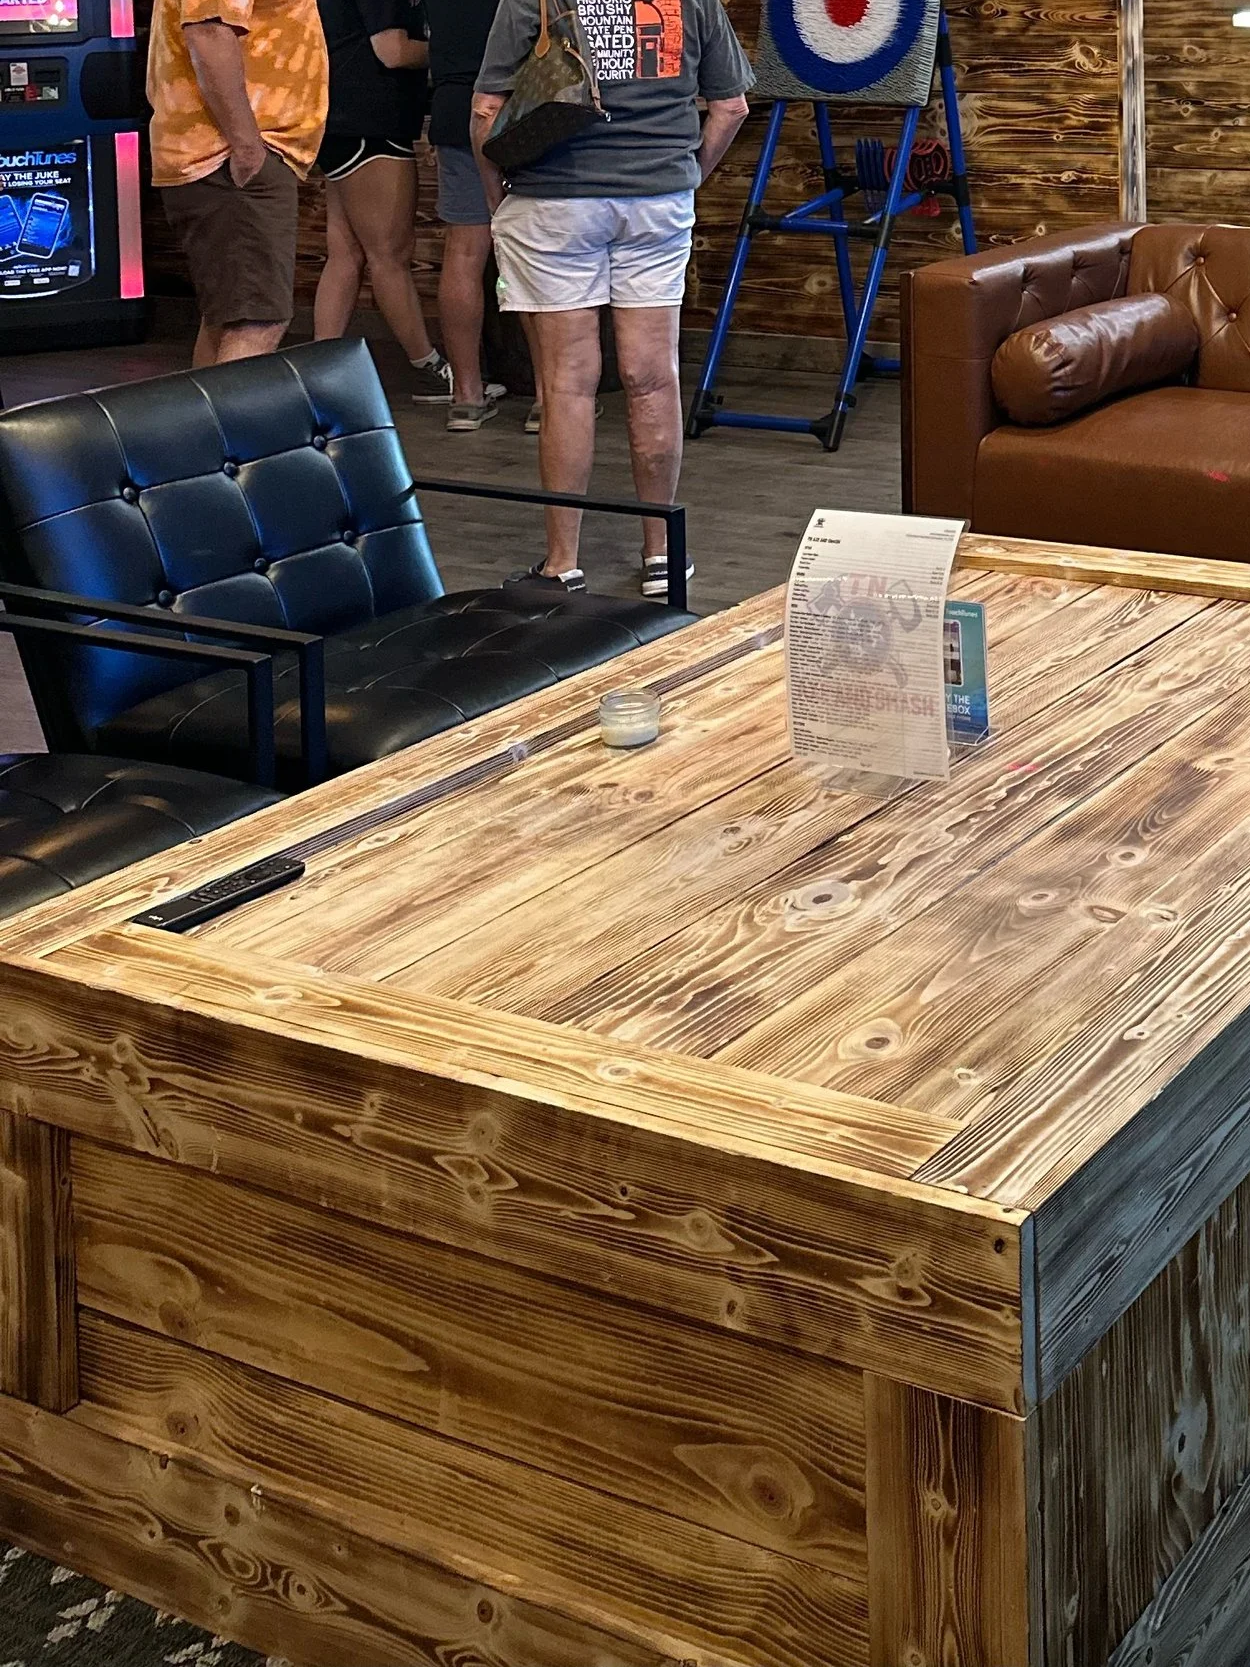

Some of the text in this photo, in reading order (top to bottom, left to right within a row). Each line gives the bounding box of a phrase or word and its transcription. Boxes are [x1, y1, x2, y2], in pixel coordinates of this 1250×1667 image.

[578, 4, 632, 16] BRUSHY
[601, 58, 635, 70] HOUR
[597, 70, 634, 81] CURITY
[0, 151, 77, 168] ouchTunes
[14, 172, 33, 181] THE
[35, 170, 60, 180] JUKE
[953, 694, 971, 705] THE
[946, 704, 971, 715] EBOX
